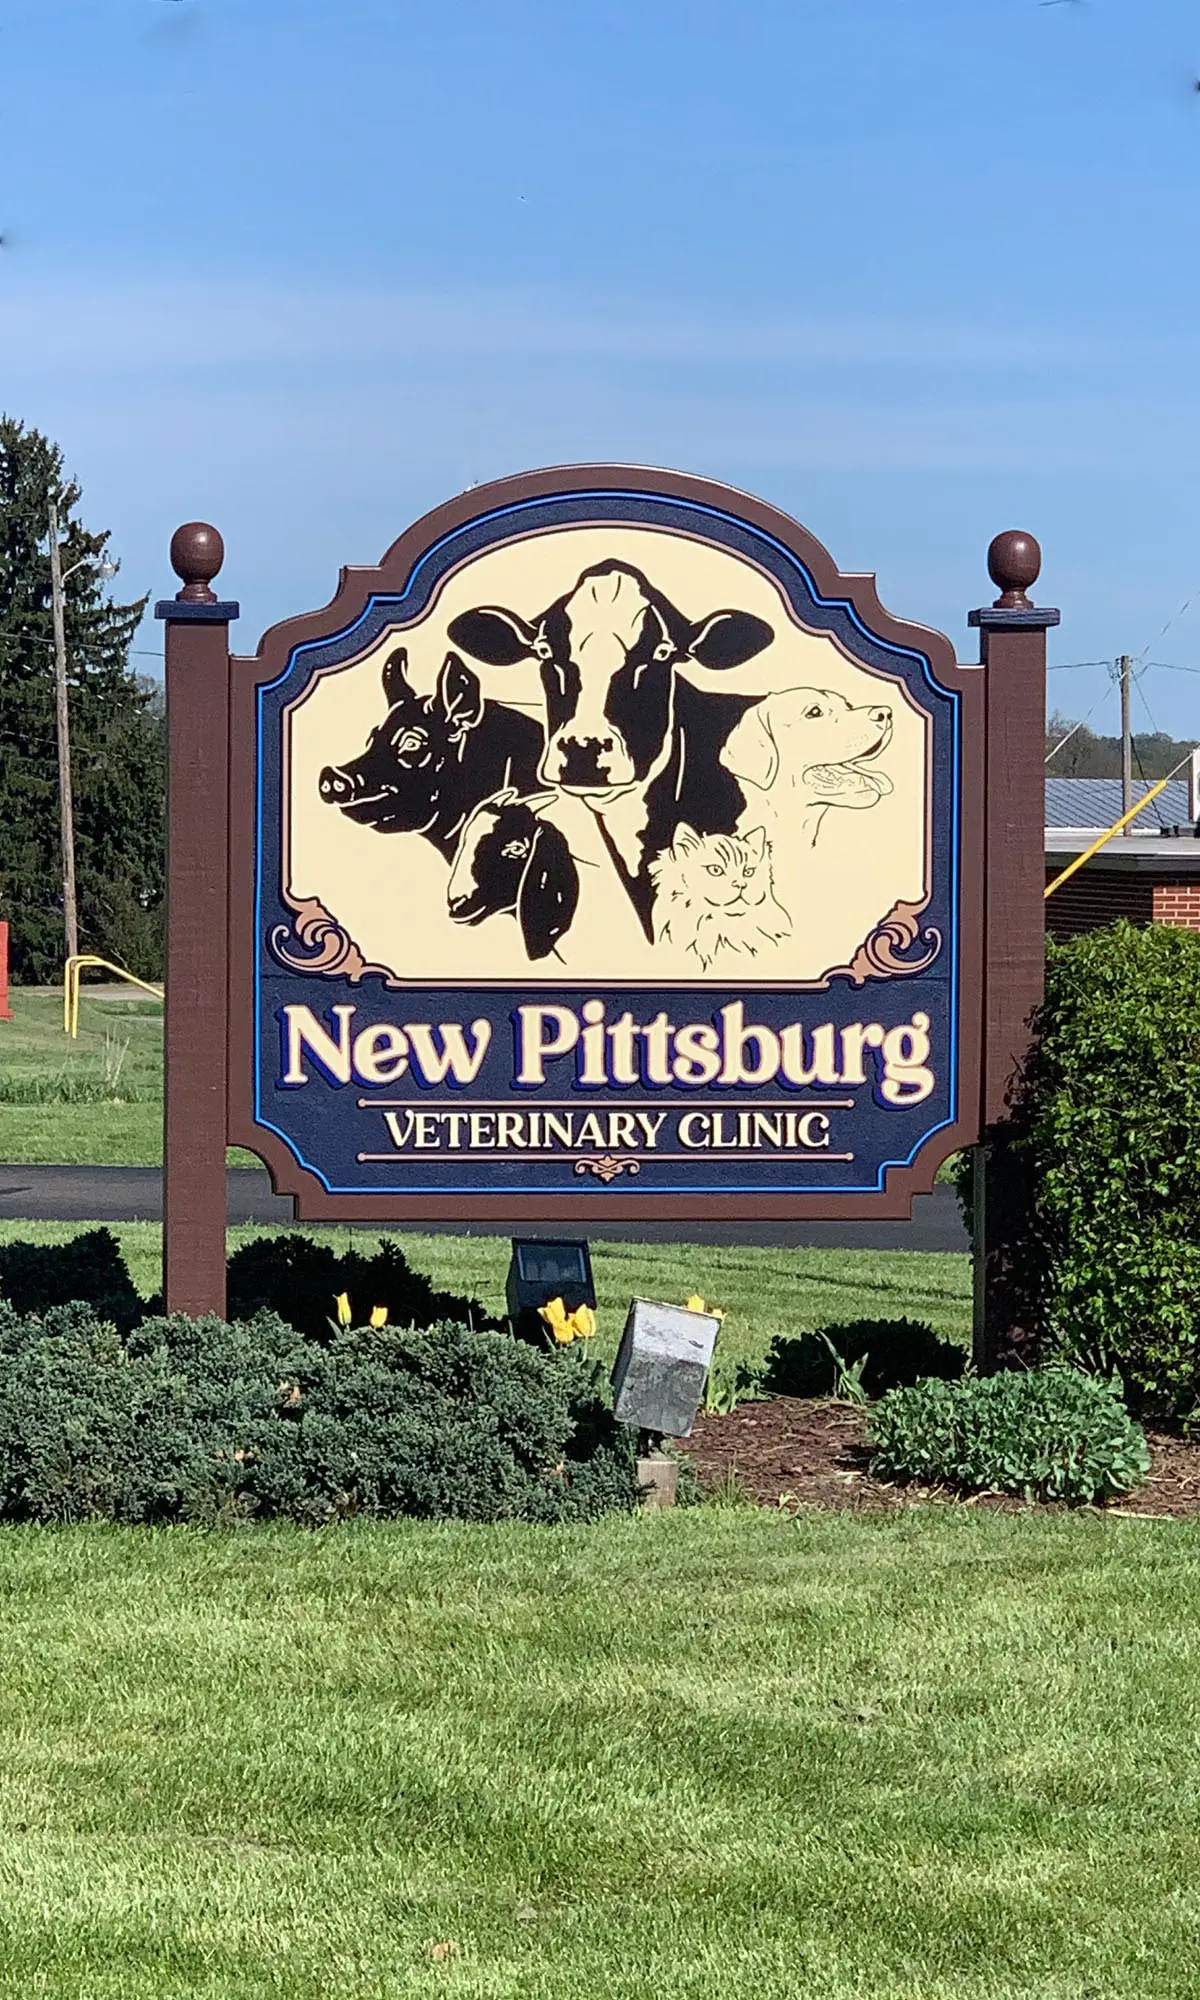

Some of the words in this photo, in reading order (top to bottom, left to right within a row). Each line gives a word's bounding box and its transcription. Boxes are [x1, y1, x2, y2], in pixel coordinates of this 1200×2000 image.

[281, 1004, 492, 1085] New
[515, 1000, 935, 1106] Pittsburg
[383, 1110, 667, 1149] VETERINARY
[678, 1111, 830, 1149] CLINIC
